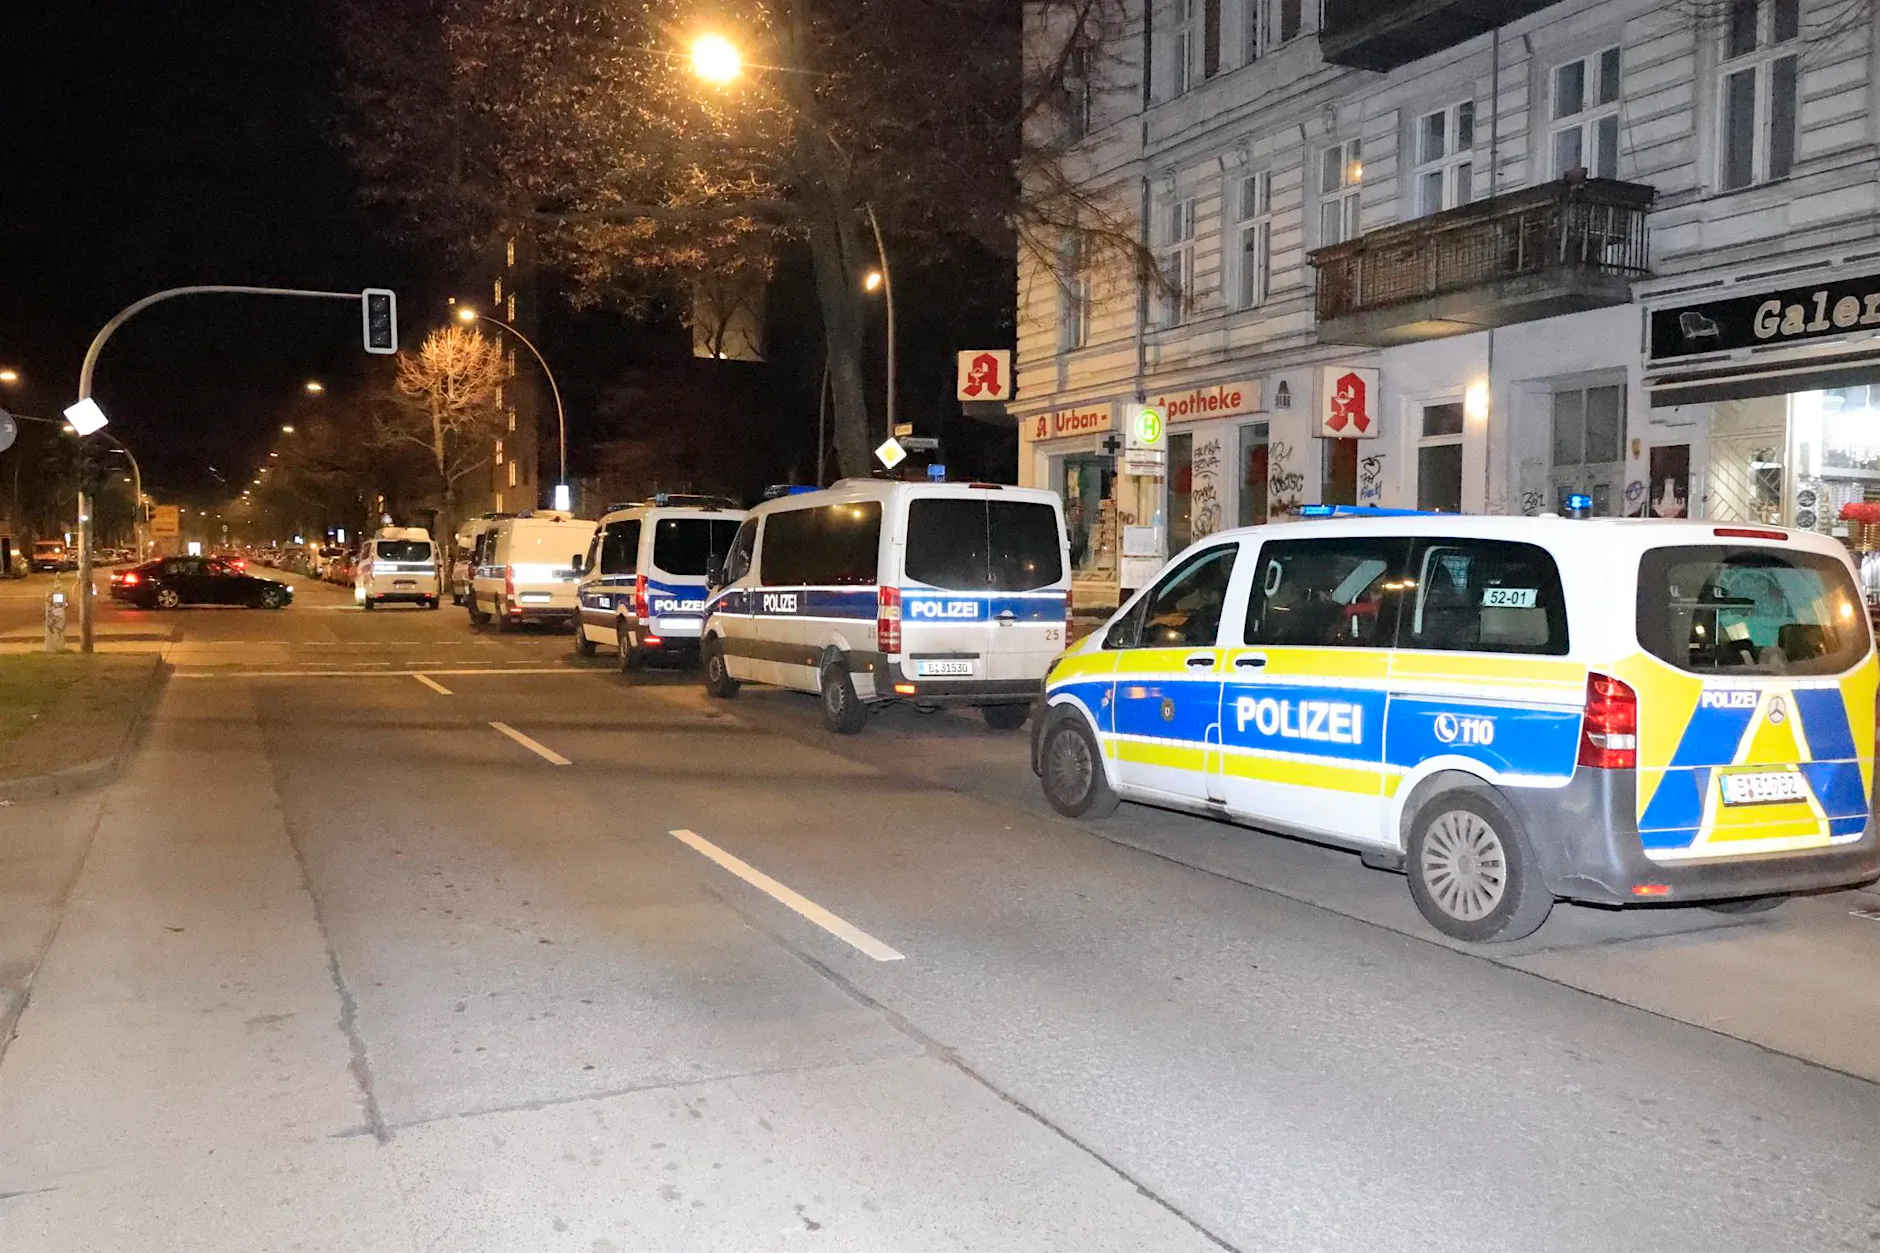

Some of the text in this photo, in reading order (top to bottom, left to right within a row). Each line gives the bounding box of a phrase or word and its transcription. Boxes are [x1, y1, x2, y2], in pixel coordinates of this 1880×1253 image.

[655, 599, 705, 611] POLIZEI
[763, 594, 798, 613] POLIZEI
[1490, 591, 1526, 605] 52-01
[910, 601, 979, 618] POLIZEI
[1045, 629, 1060, 641] 25
[1702, 691, 1757, 709] POLIZEI
[1236, 696, 1363, 745] POLIZEI
[1461, 718, 1494, 745] 110
